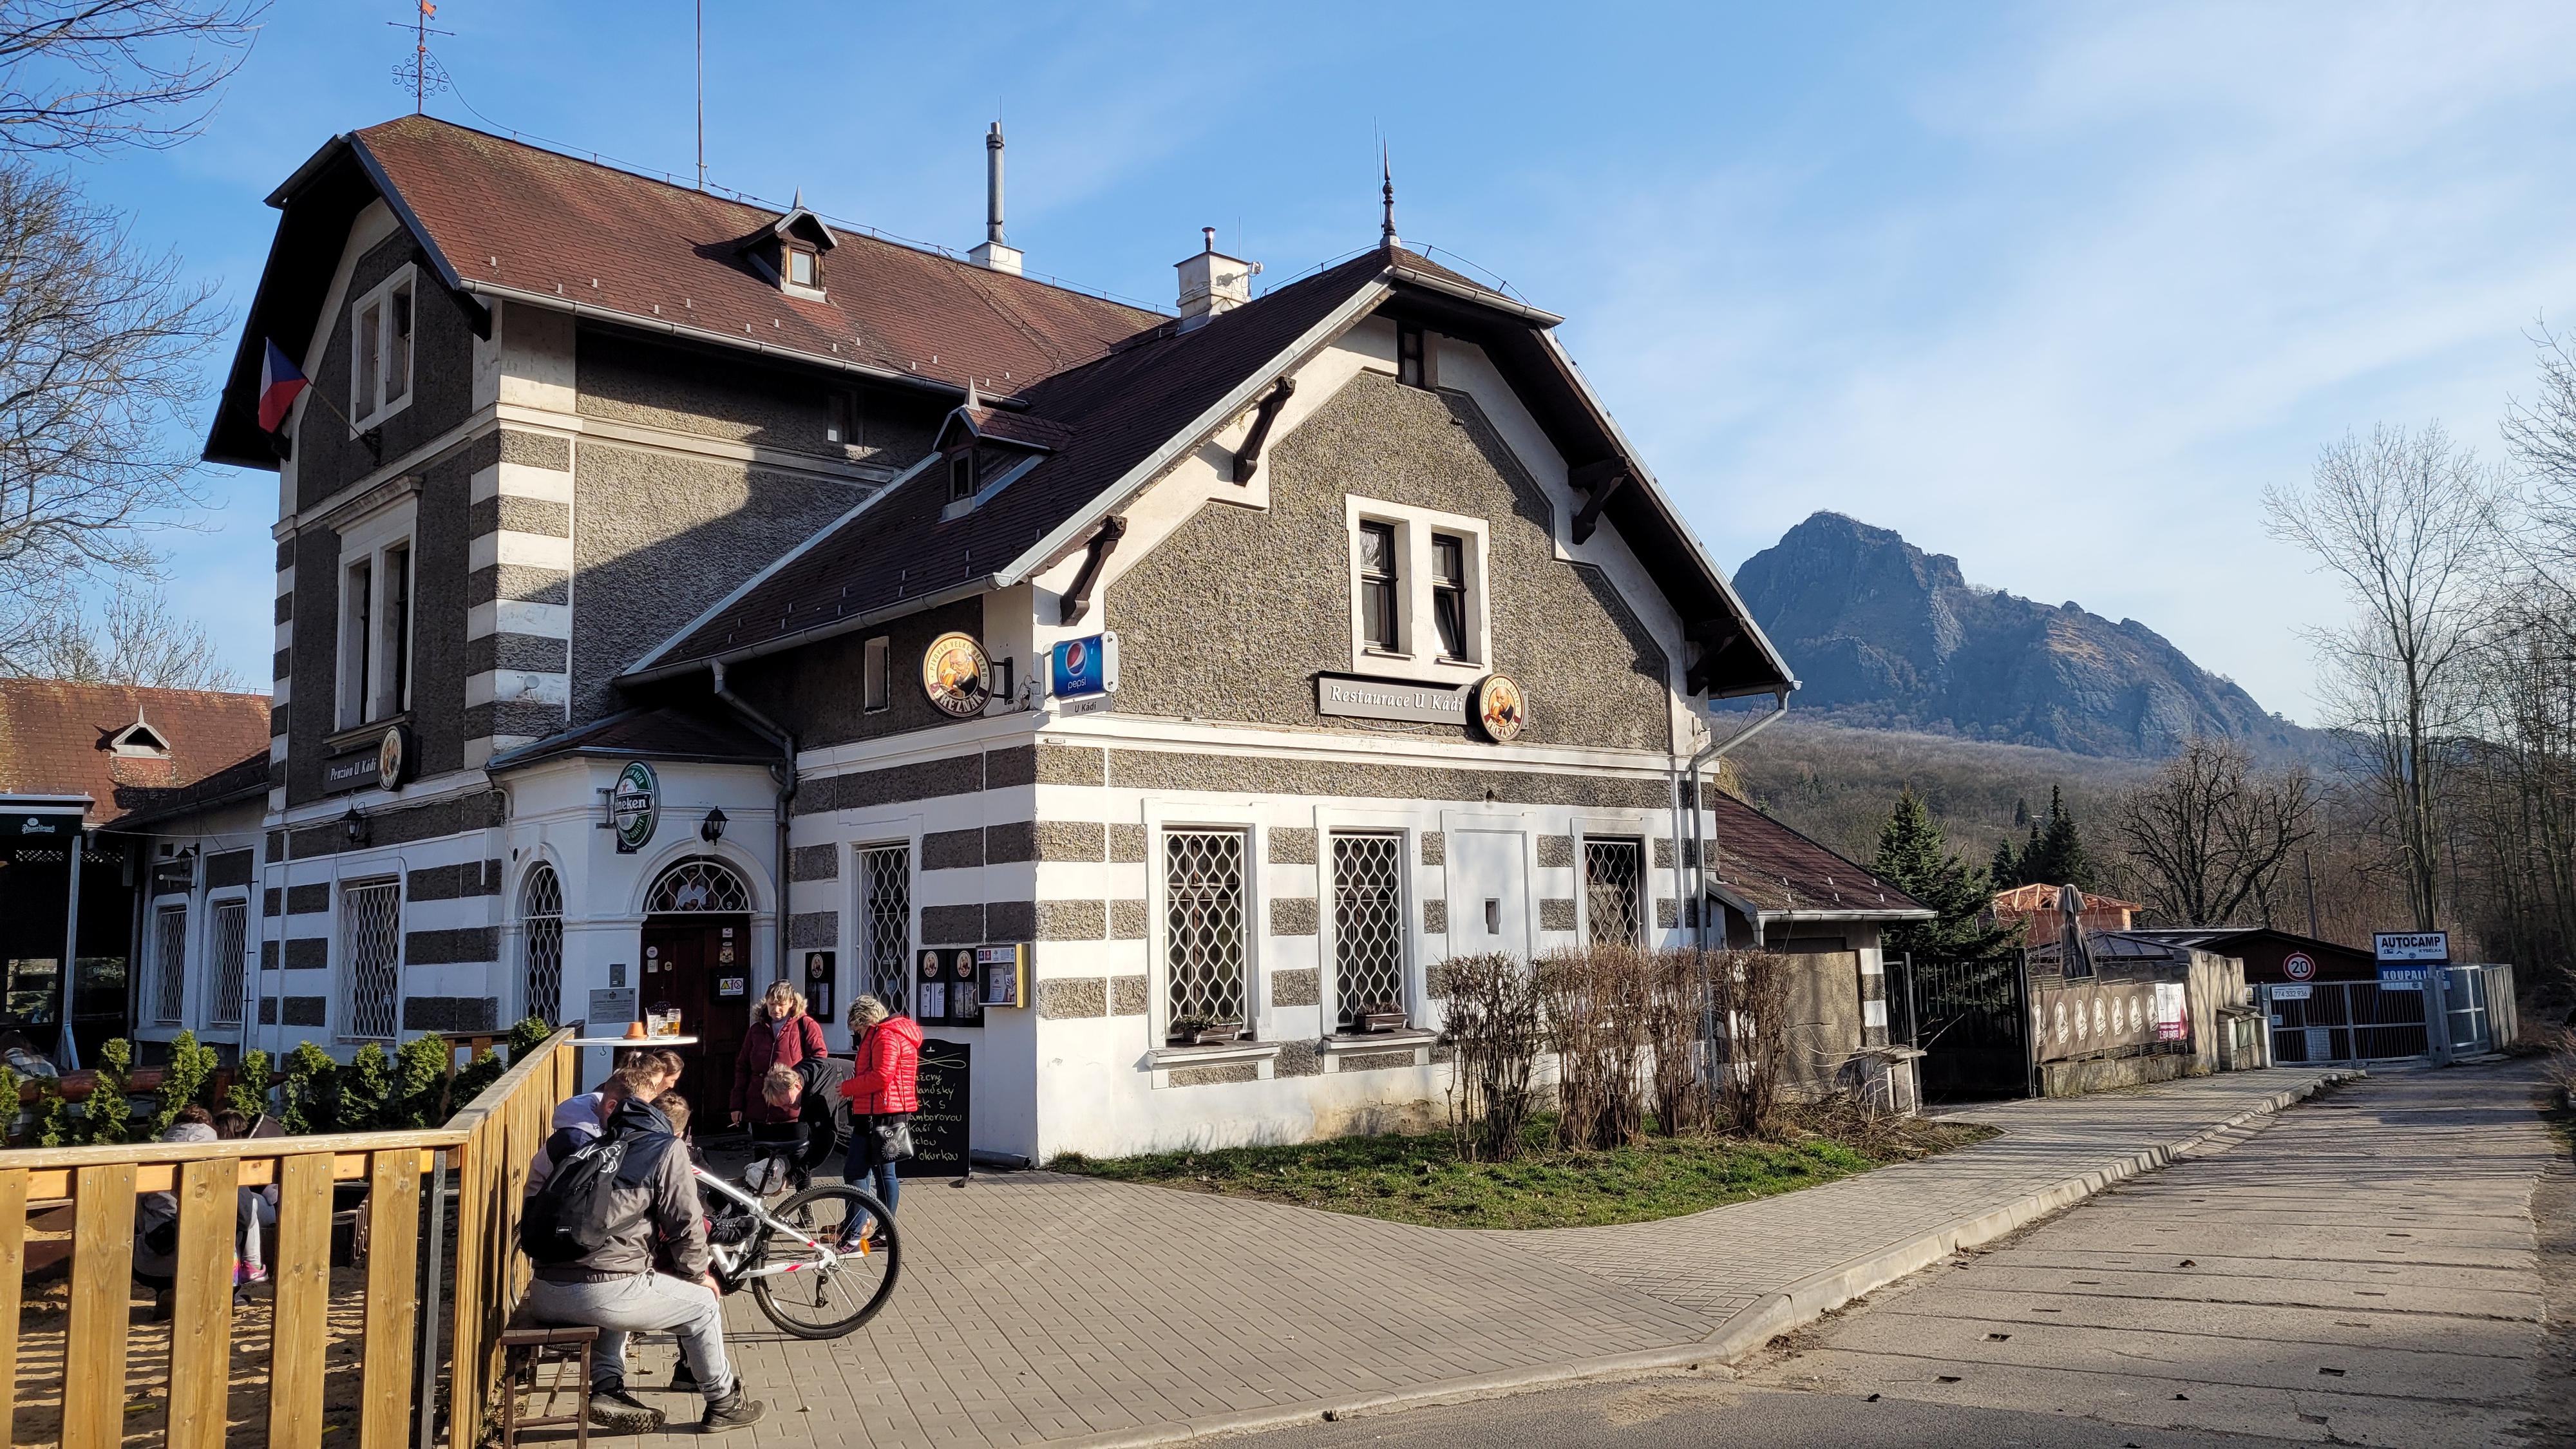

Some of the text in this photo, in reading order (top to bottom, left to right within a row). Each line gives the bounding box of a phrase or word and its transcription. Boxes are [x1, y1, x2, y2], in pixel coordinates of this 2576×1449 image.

[930, 644, 948, 670] PIVOVAR
[1068, 676, 1086, 690] pepsi
[1329, 685, 1463, 712] Restaurace U Kádi
[1081, 701, 1097, 712] Kádi
[330, 758, 377, 781] Penzion U Kádi
[633, 771, 644, 785] BEER
[630, 818, 644, 838] QUALITY
[2382, 936, 2440, 947] AUTOCAMP
[2291, 961, 2309, 974] 20
[938, 1099, 945, 1109] s
[938, 1125, 948, 1134] a
[918, 1149, 958, 1161] okurkou
